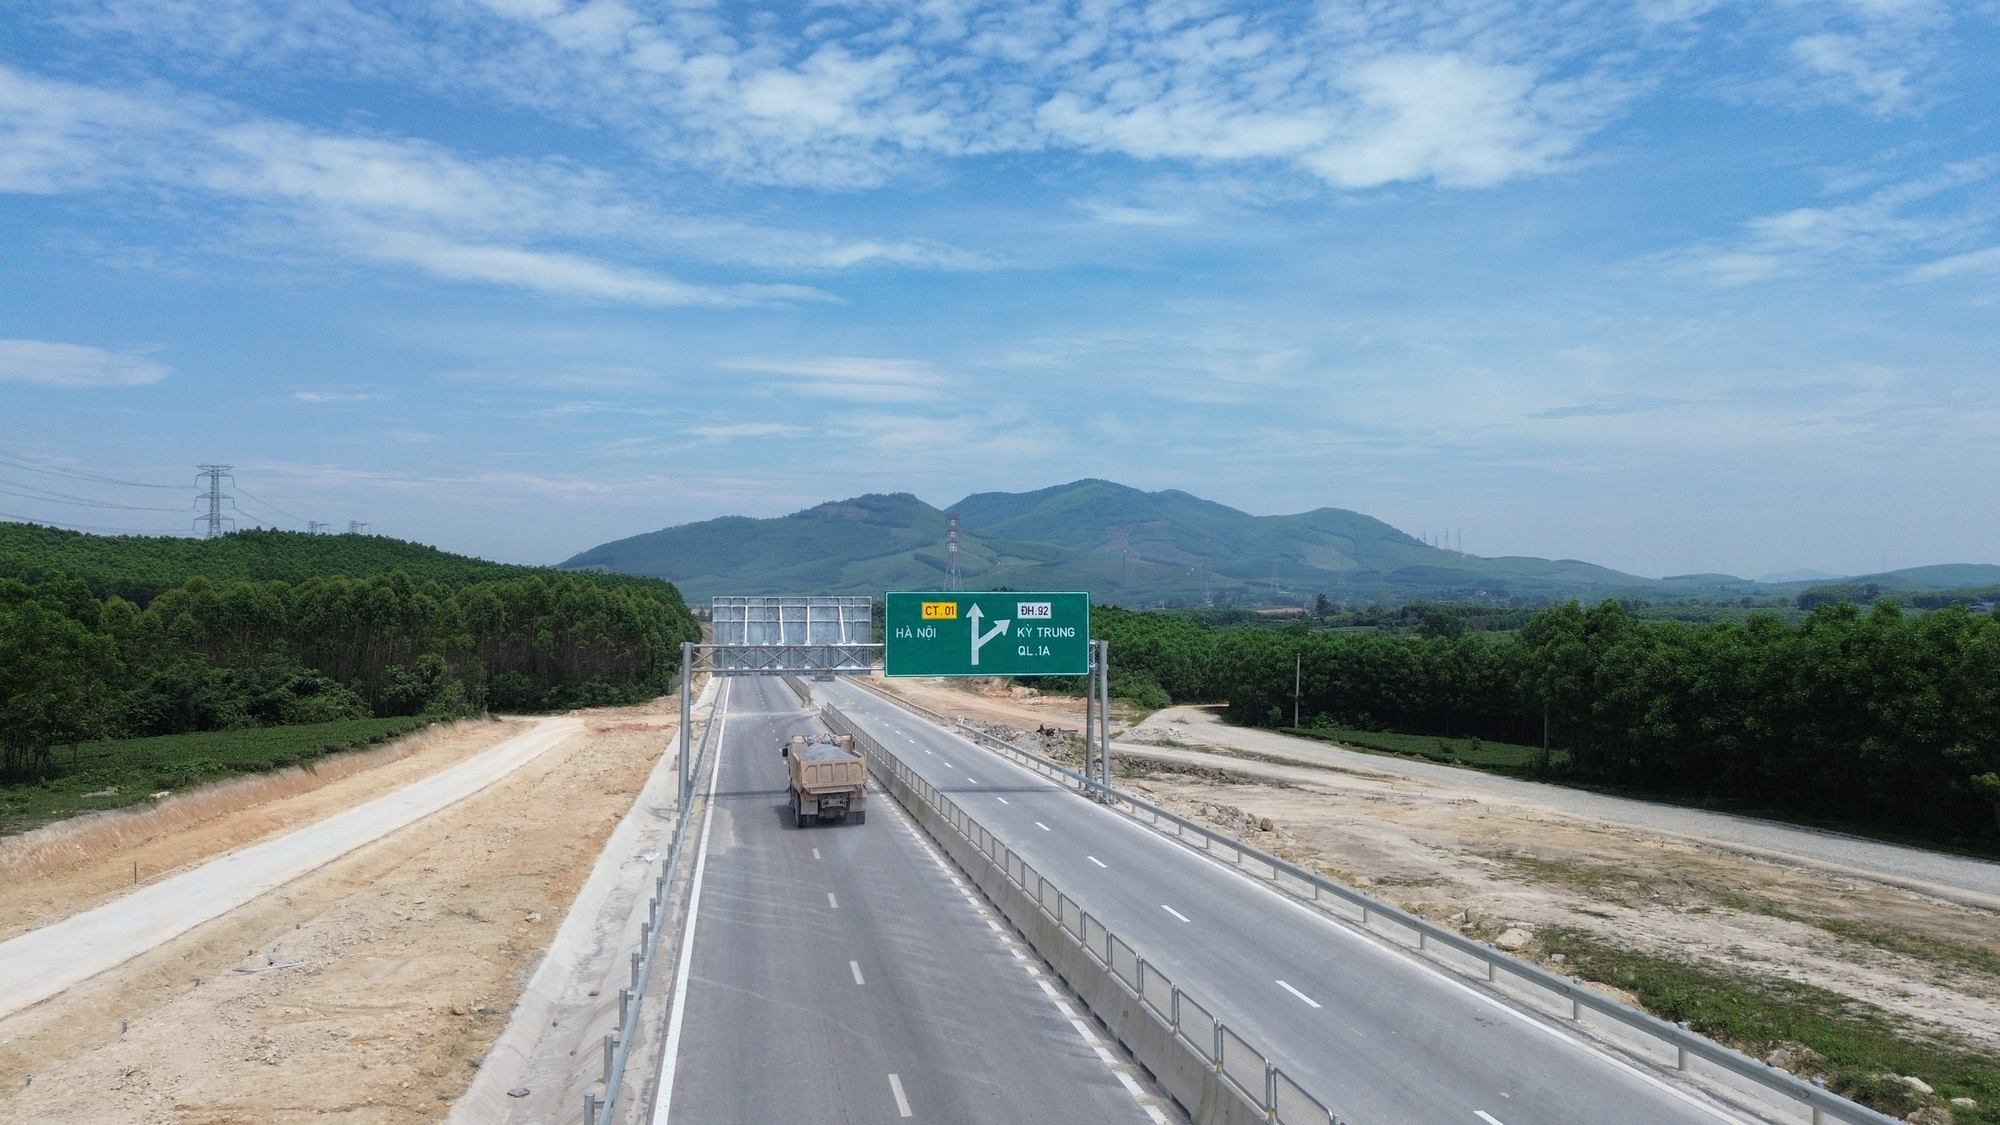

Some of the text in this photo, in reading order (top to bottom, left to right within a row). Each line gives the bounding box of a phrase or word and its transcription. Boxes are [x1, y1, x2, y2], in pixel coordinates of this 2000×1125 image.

[1020, 606, 1049, 616] ĐH.92
[895, 625, 936, 641] HÀ NỘI
[1017, 623, 1075, 638] KỲ TRUNG
[1018, 645, 1051, 656] QL.1A
